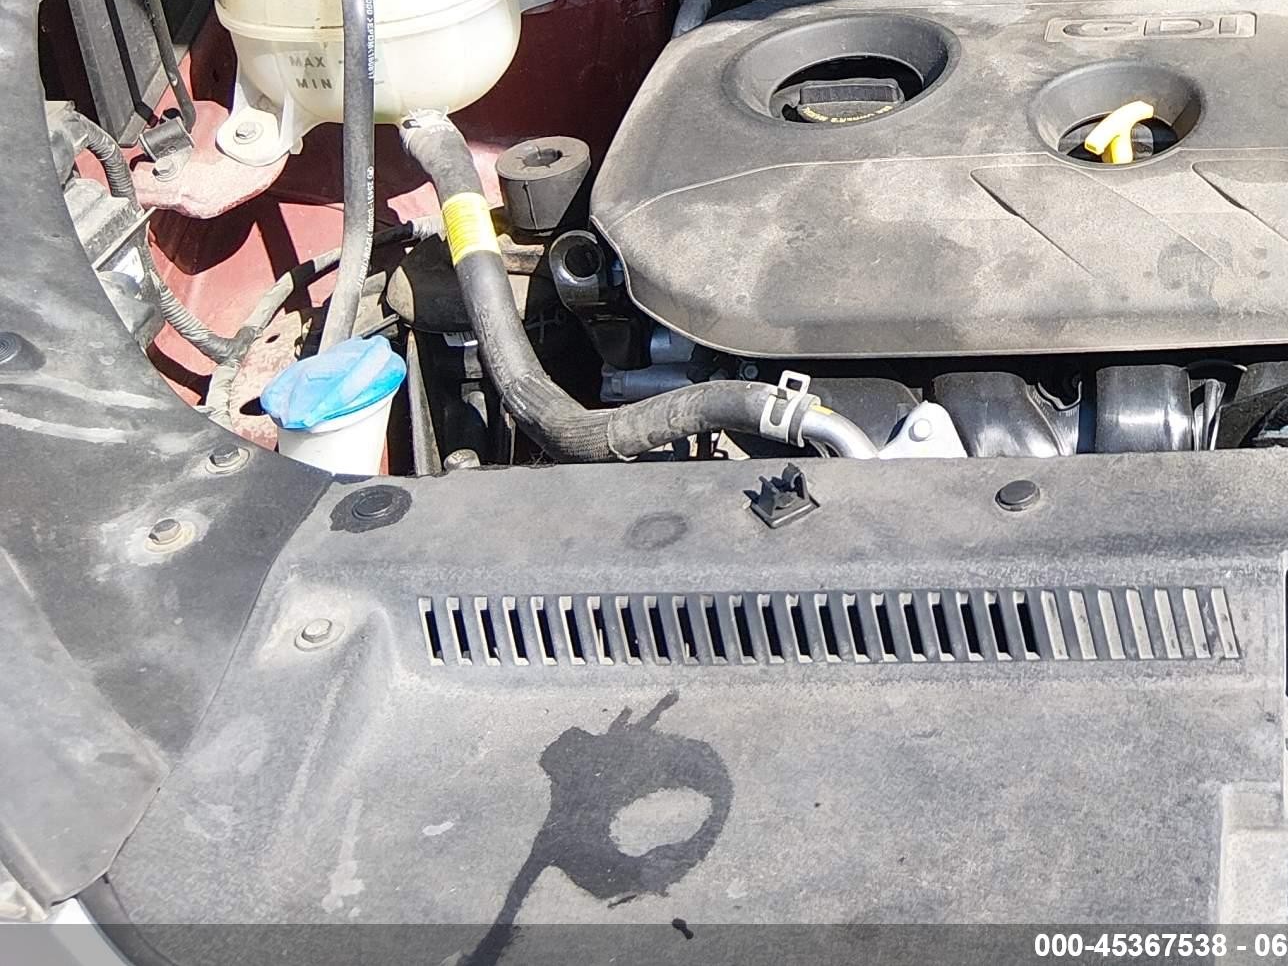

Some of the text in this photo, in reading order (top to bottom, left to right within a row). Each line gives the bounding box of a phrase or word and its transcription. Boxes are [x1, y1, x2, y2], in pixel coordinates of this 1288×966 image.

[1062, 17, 1238, 39] GDI
[289, 56, 326, 68] MAX
[295, 78, 333, 90] MIN
